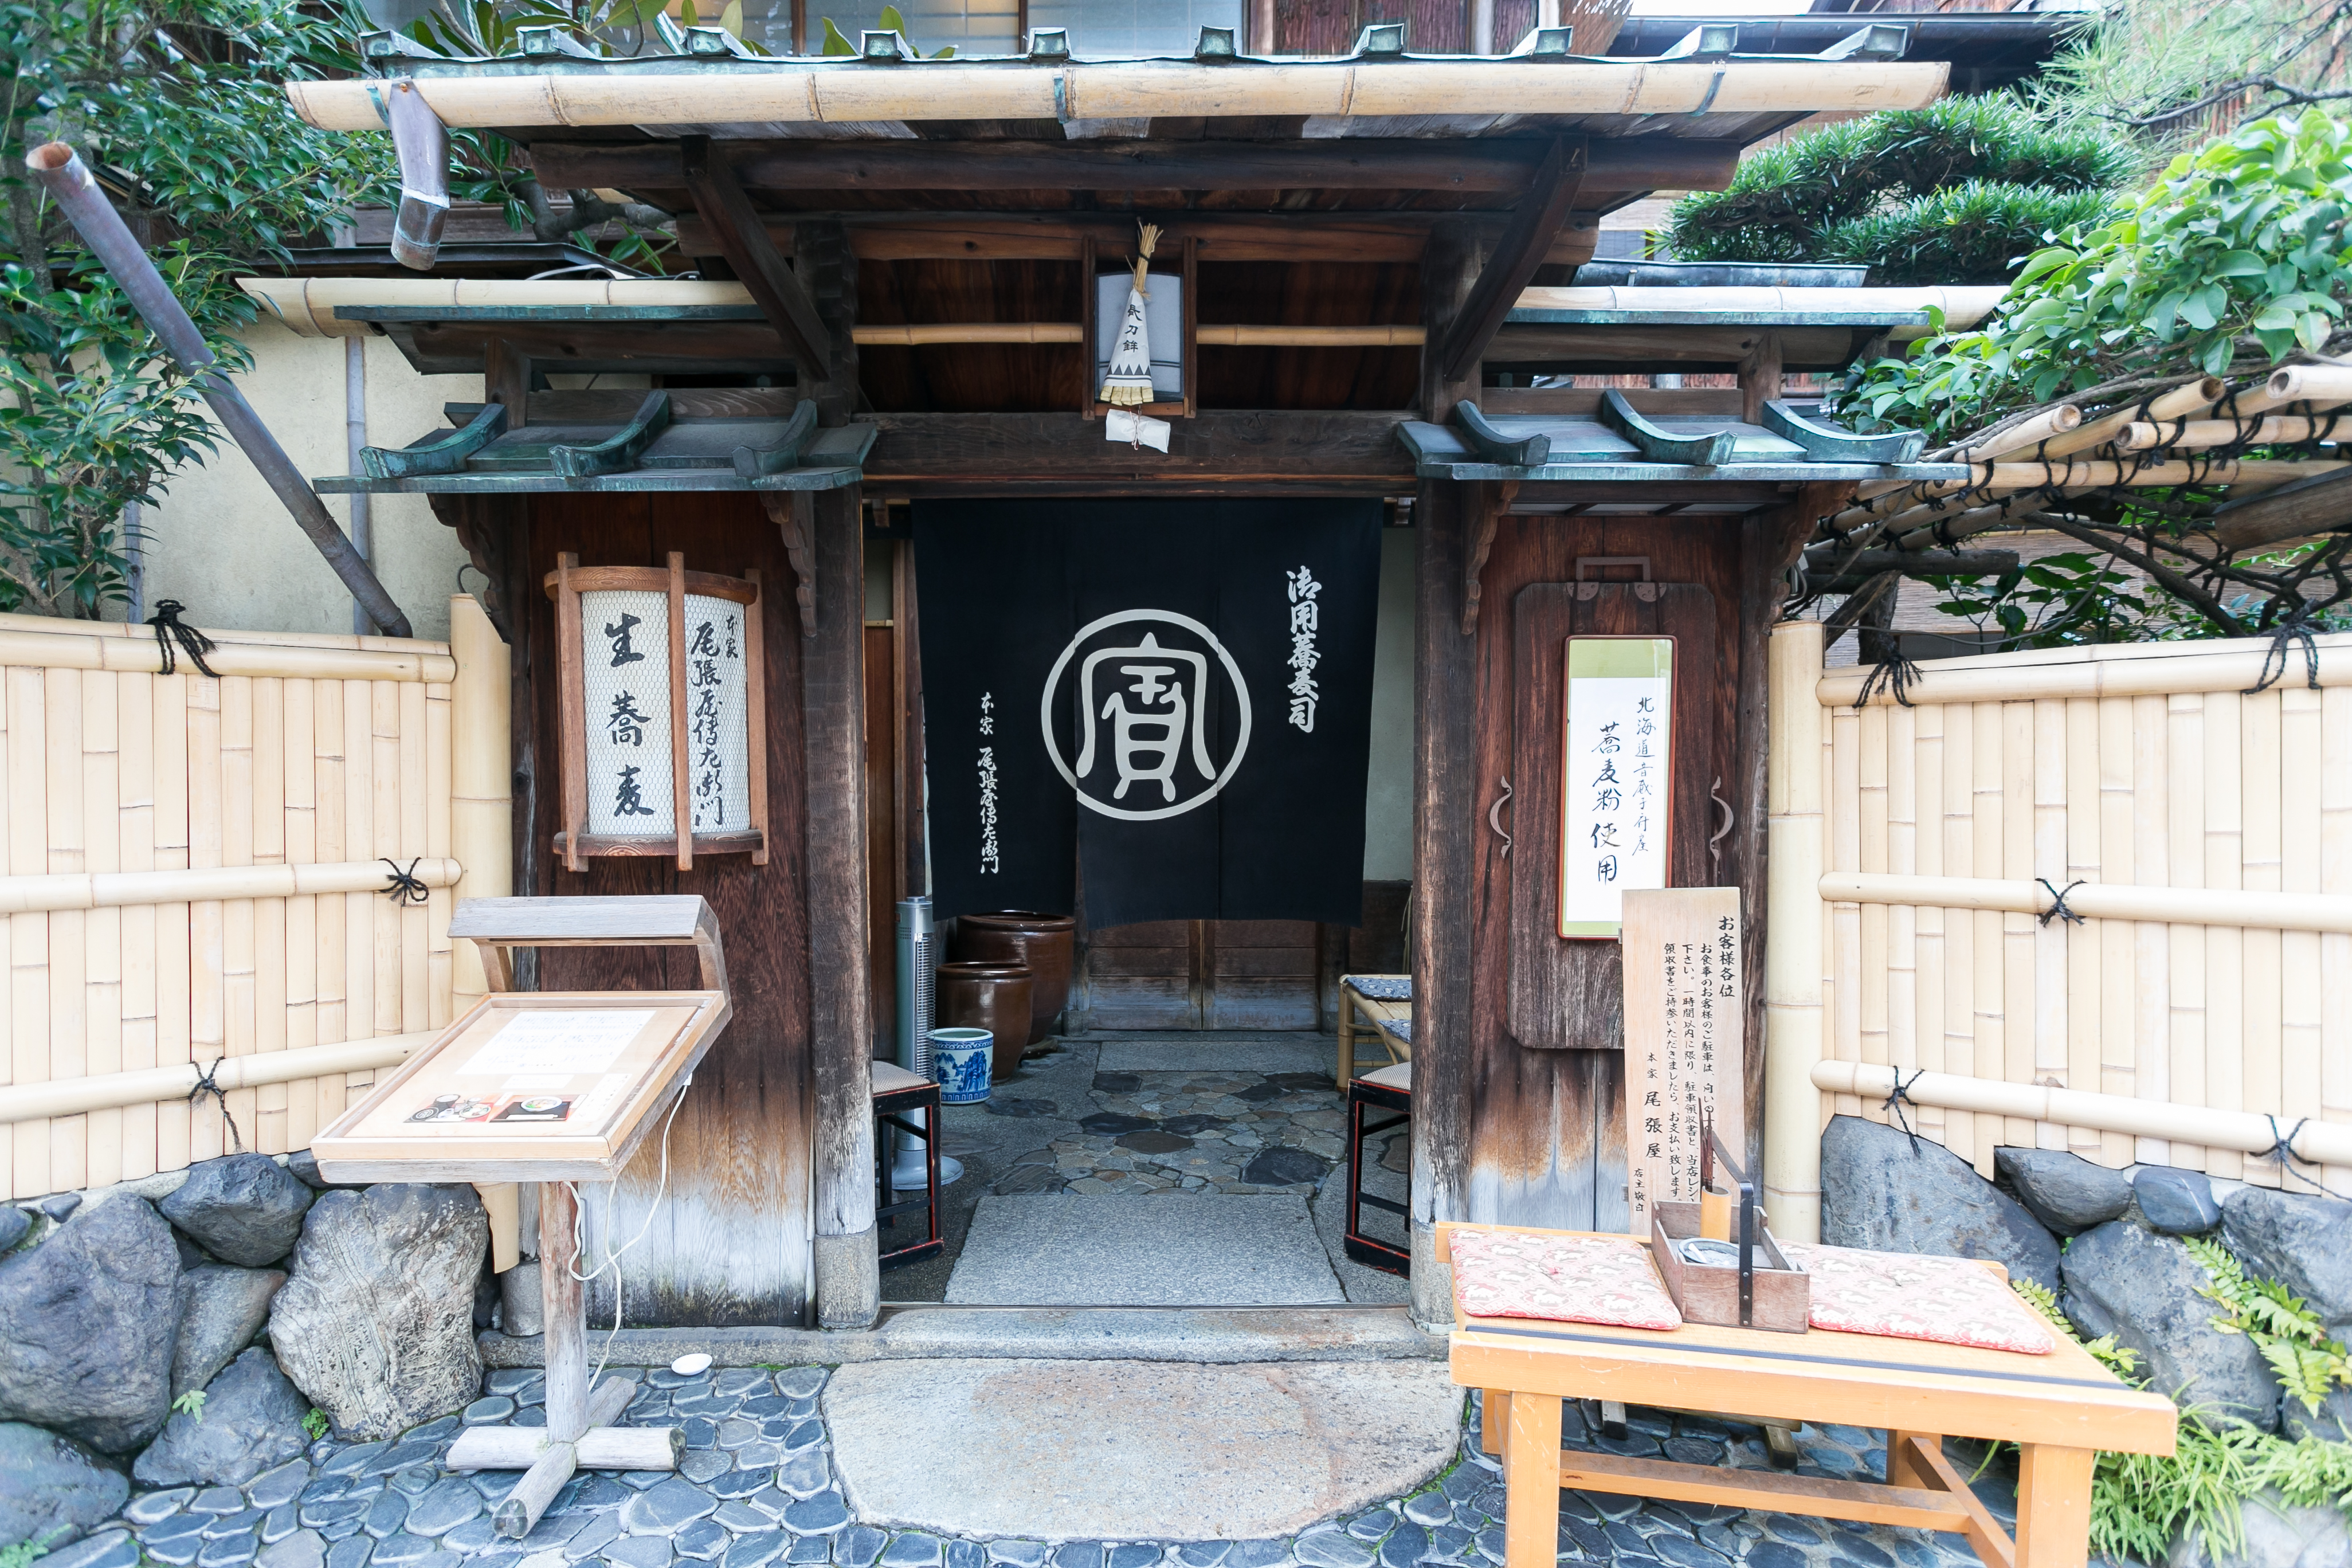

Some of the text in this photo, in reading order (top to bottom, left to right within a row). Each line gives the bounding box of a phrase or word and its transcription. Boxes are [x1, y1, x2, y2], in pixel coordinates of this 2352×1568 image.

[1590, 720, 1623, 886] 蕎麦粉使用
[1718, 915, 1736, 998] お客様各位
[1644, 1091, 1663, 1159] 尾張屋
[1633, 1167, 1645, 1212] 店主敬白
